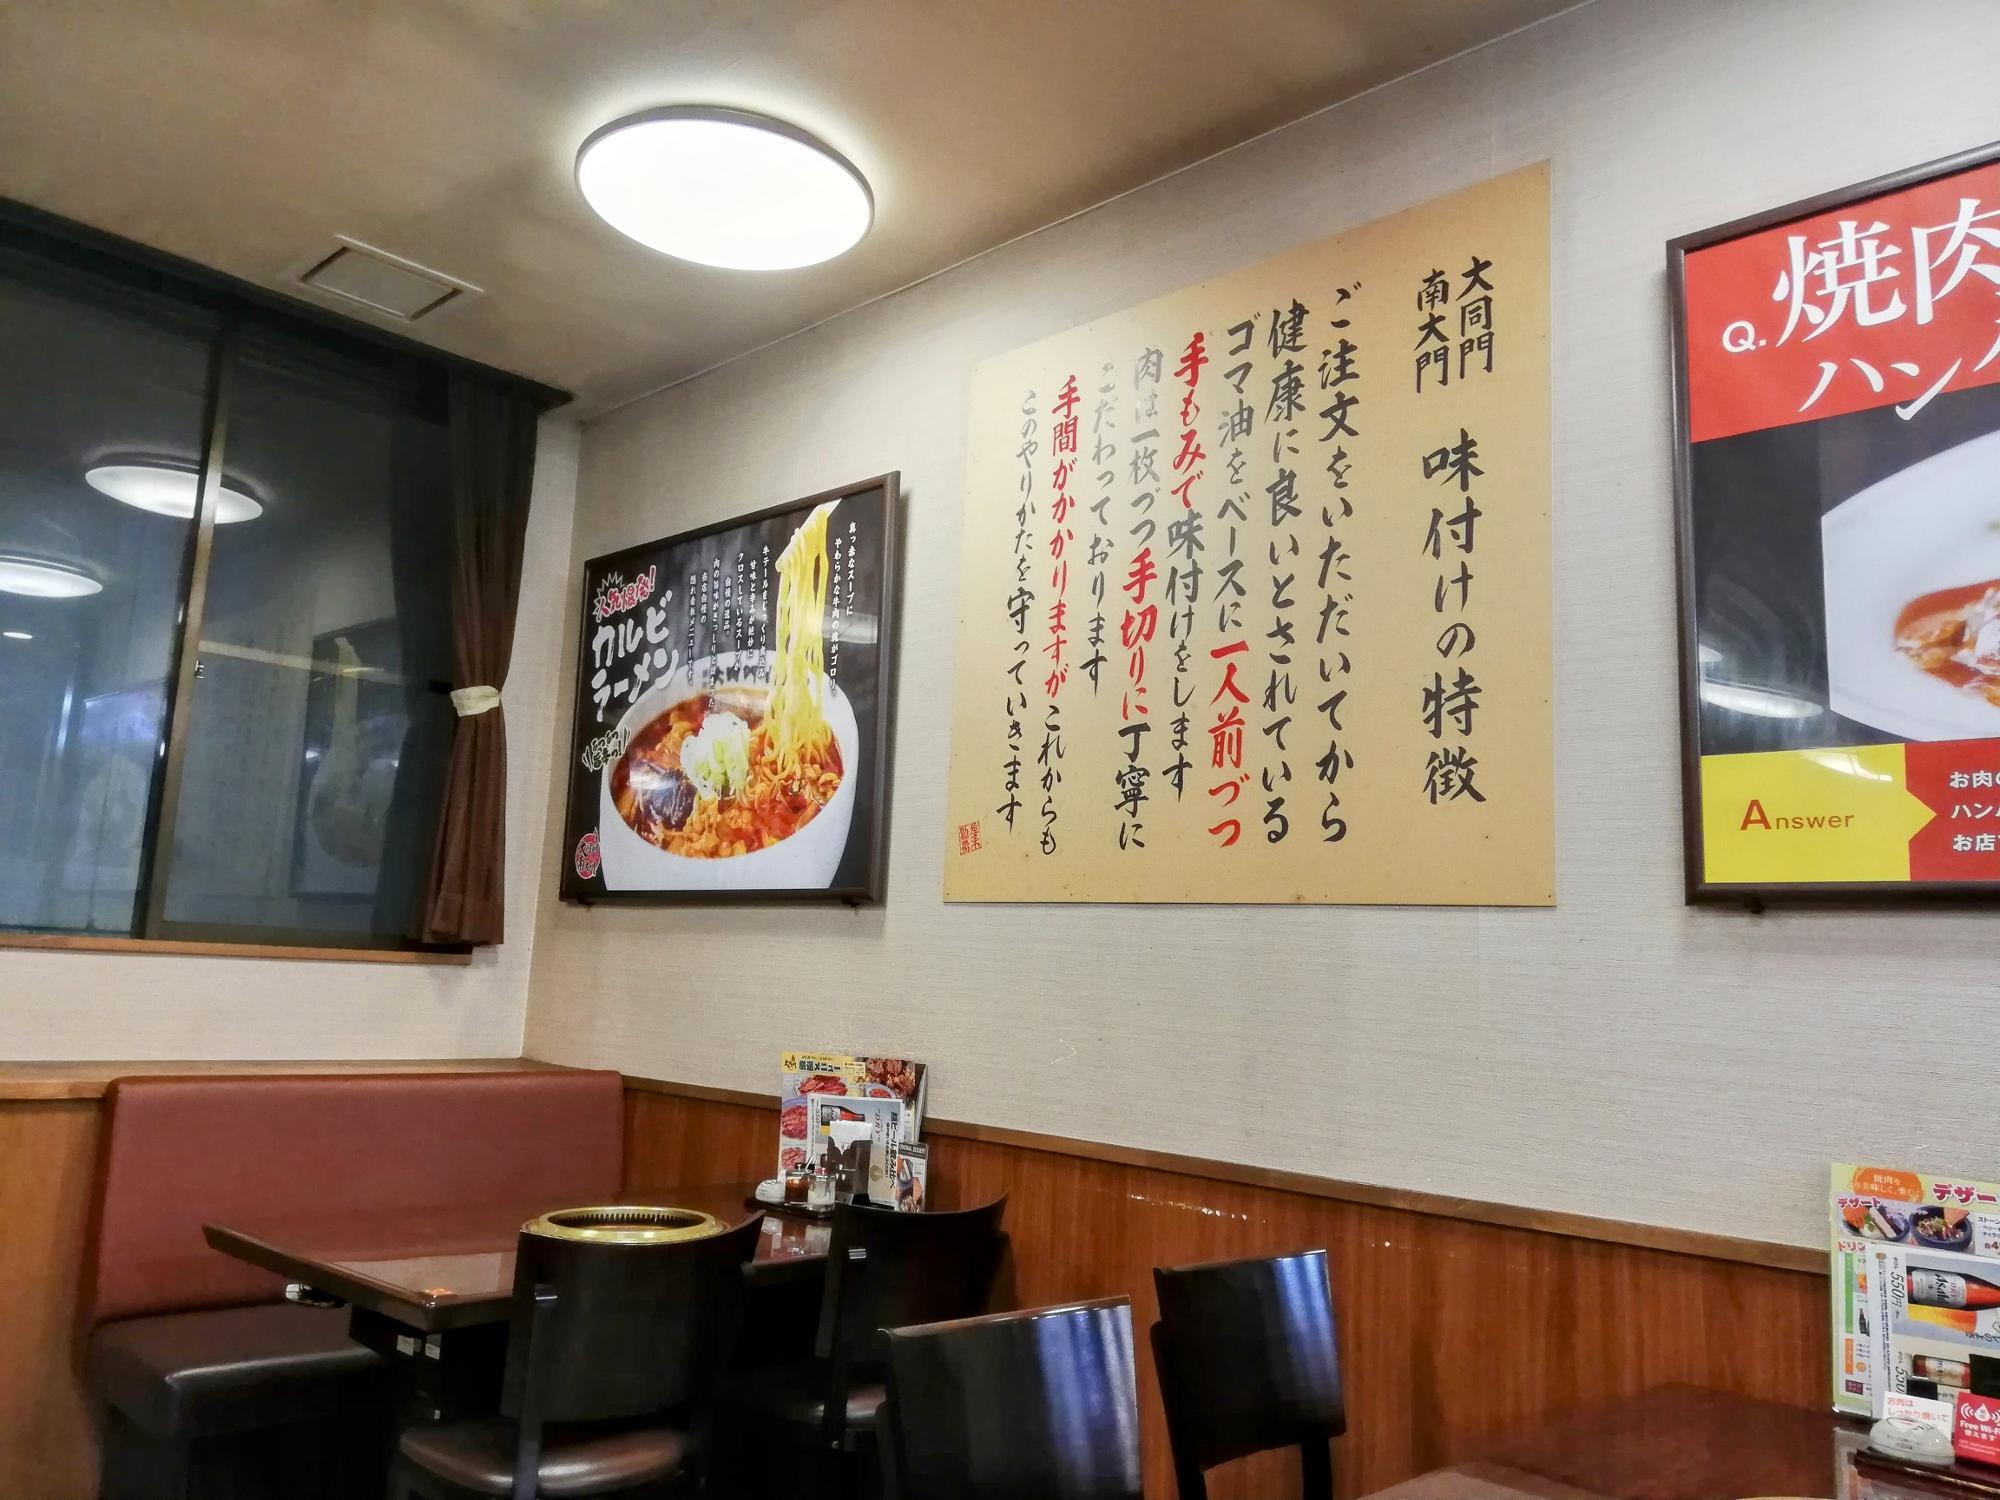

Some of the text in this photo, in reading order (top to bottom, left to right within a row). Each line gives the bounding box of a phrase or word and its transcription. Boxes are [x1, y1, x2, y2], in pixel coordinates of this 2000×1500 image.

[1415, 268, 1449, 393] 南大門
[1457, 256, 1494, 379] 大同門
[1722, 320, 1767, 352] Q.
[591, 648, 679, 723] ラーメン
[592, 589, 673, 668] カルビ
[995, 389, 1038, 833] このやりかたを守っていきます
[1037, 374, 1080, 856] 手間がかかりますがこれからも
[1078, 358, 1117, 696] こだわっております
[1115, 345, 1164, 851] 肉は一枚づつ手切りに丁寧に
[1162, 332, 1210, 803] 手もみで味付けをします
[1208, 315, 1259, 848] ゴマ油をベースに一人前づつ
[1262, 298, 1311, 846] 健康に良いとされている
[1317, 281, 1363, 844] ご注文をいただいてから
[1421, 428, 1487, 805] 味付けの特徴
[1740, 799, 1855, 832] Answer
[1952, 833, 2000, 852] お店
[1960, 1420, 2000, 1435] Free Wi-F
